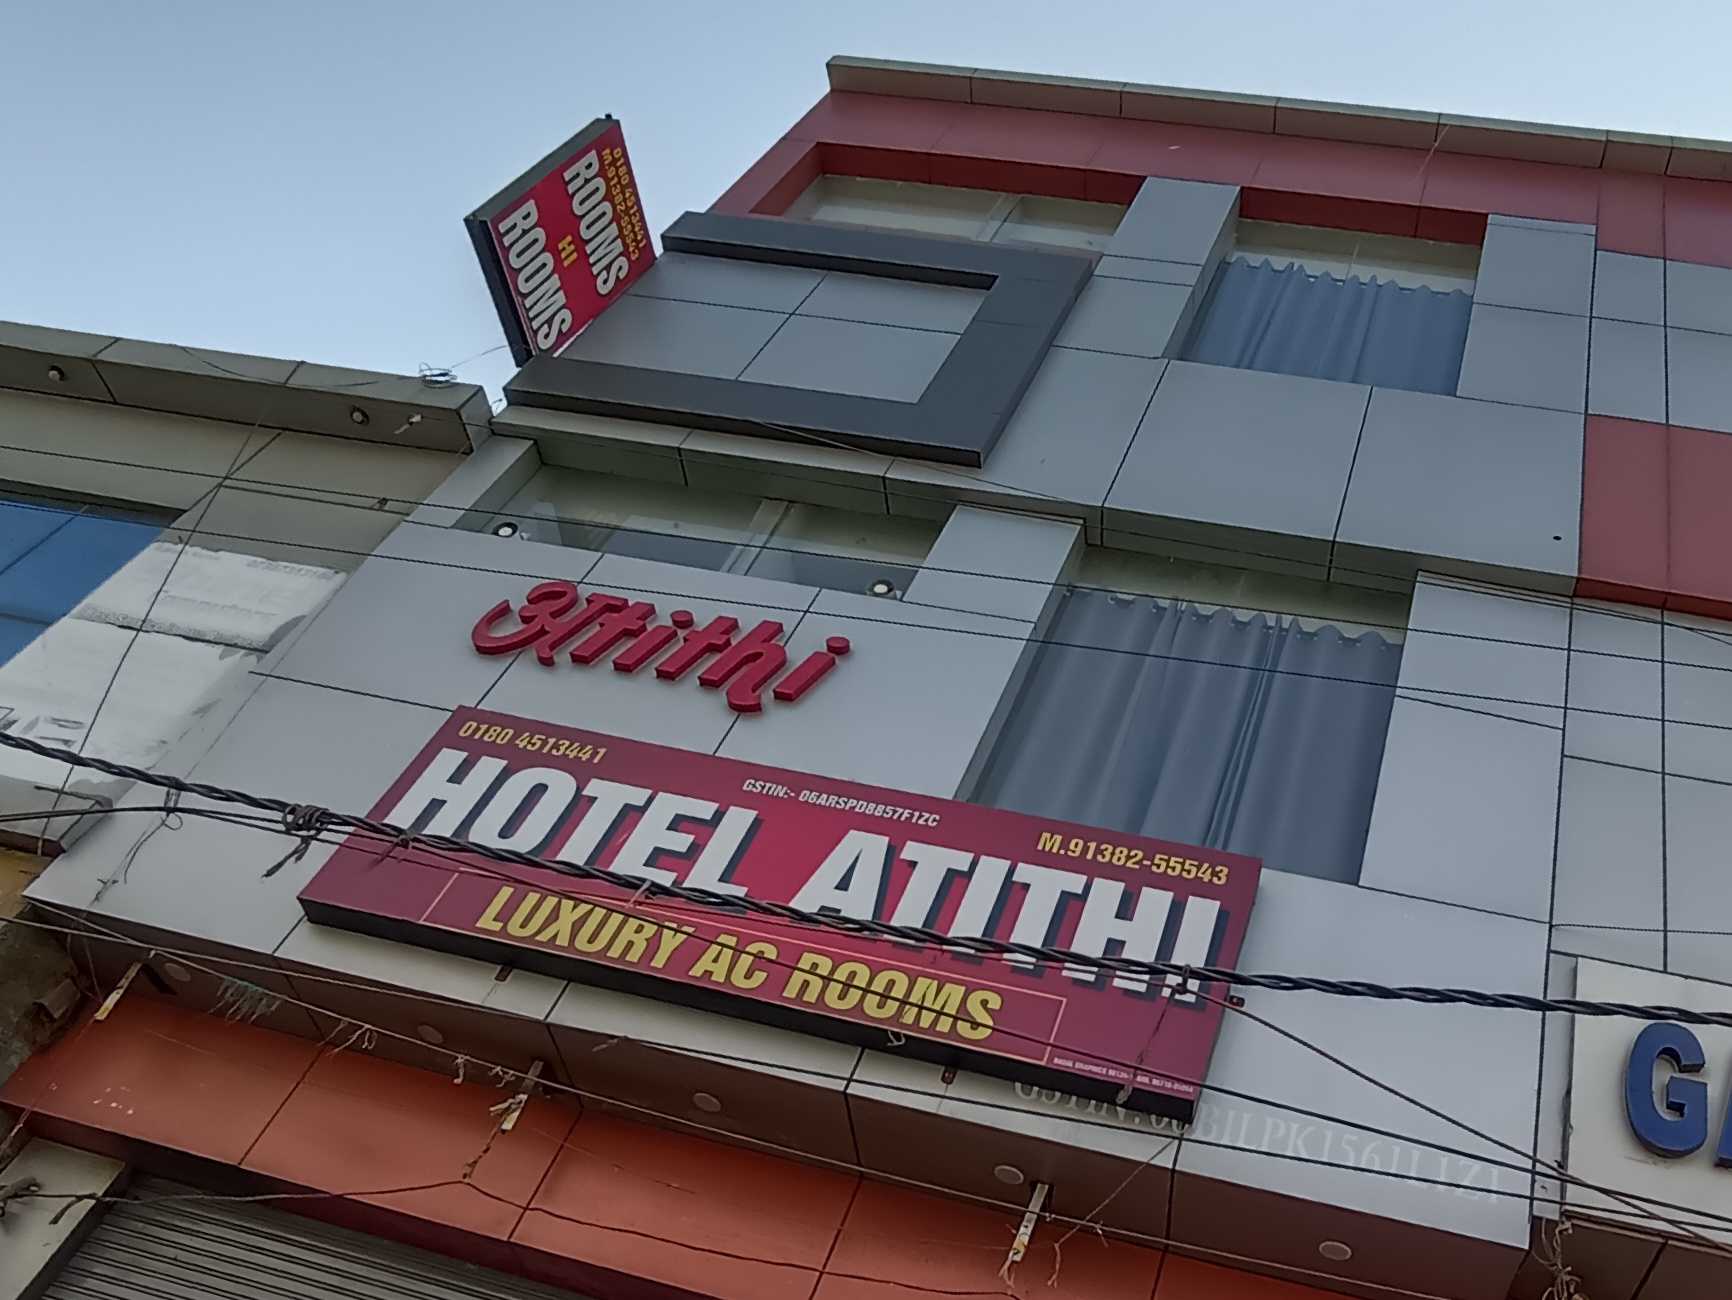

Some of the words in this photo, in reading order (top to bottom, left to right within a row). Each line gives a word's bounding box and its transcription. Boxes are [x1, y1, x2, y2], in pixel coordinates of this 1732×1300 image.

[498, 199, 573, 350] ROOMS
[557, 235, 579, 268] HI
[562, 149, 630, 296] ROOMS
[458, 720, 513, 746] 0180
[515, 731, 608, 765] 4513441
[381, 747, 761, 900] HOTEL
[786, 829, 1223, 1004] ATITHI
[1036, 831, 1230, 886] M.91382-55543
[474, 885, 699, 969] LUXURY
[688, 933, 780, 990] AC
[782, 953, 1003, 1041] ROOMS
[1625, 1021, 1732, 1169] G
